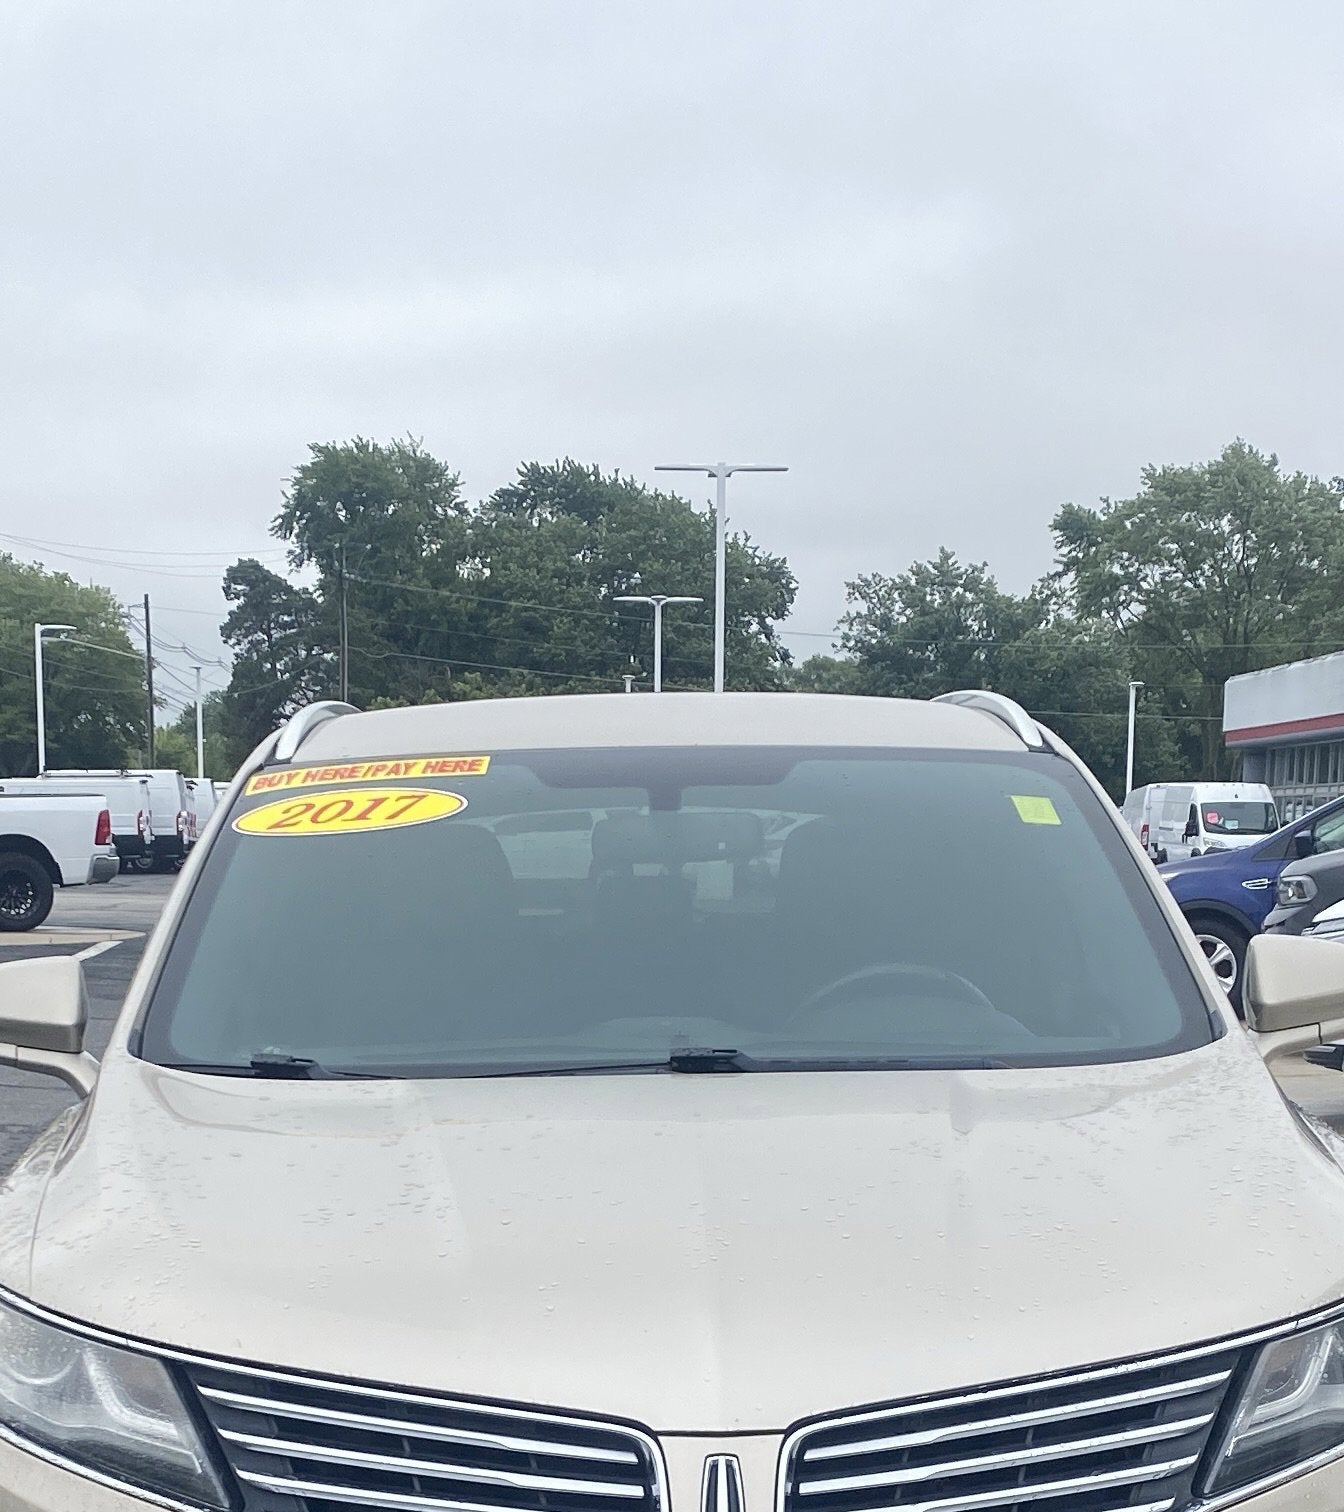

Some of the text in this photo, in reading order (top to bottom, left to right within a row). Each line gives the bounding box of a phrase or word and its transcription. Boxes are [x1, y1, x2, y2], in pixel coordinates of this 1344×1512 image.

[251, 772, 301, 791] BUY
[422, 759, 484, 774] HERE
[266, 795, 430, 830] 2017
